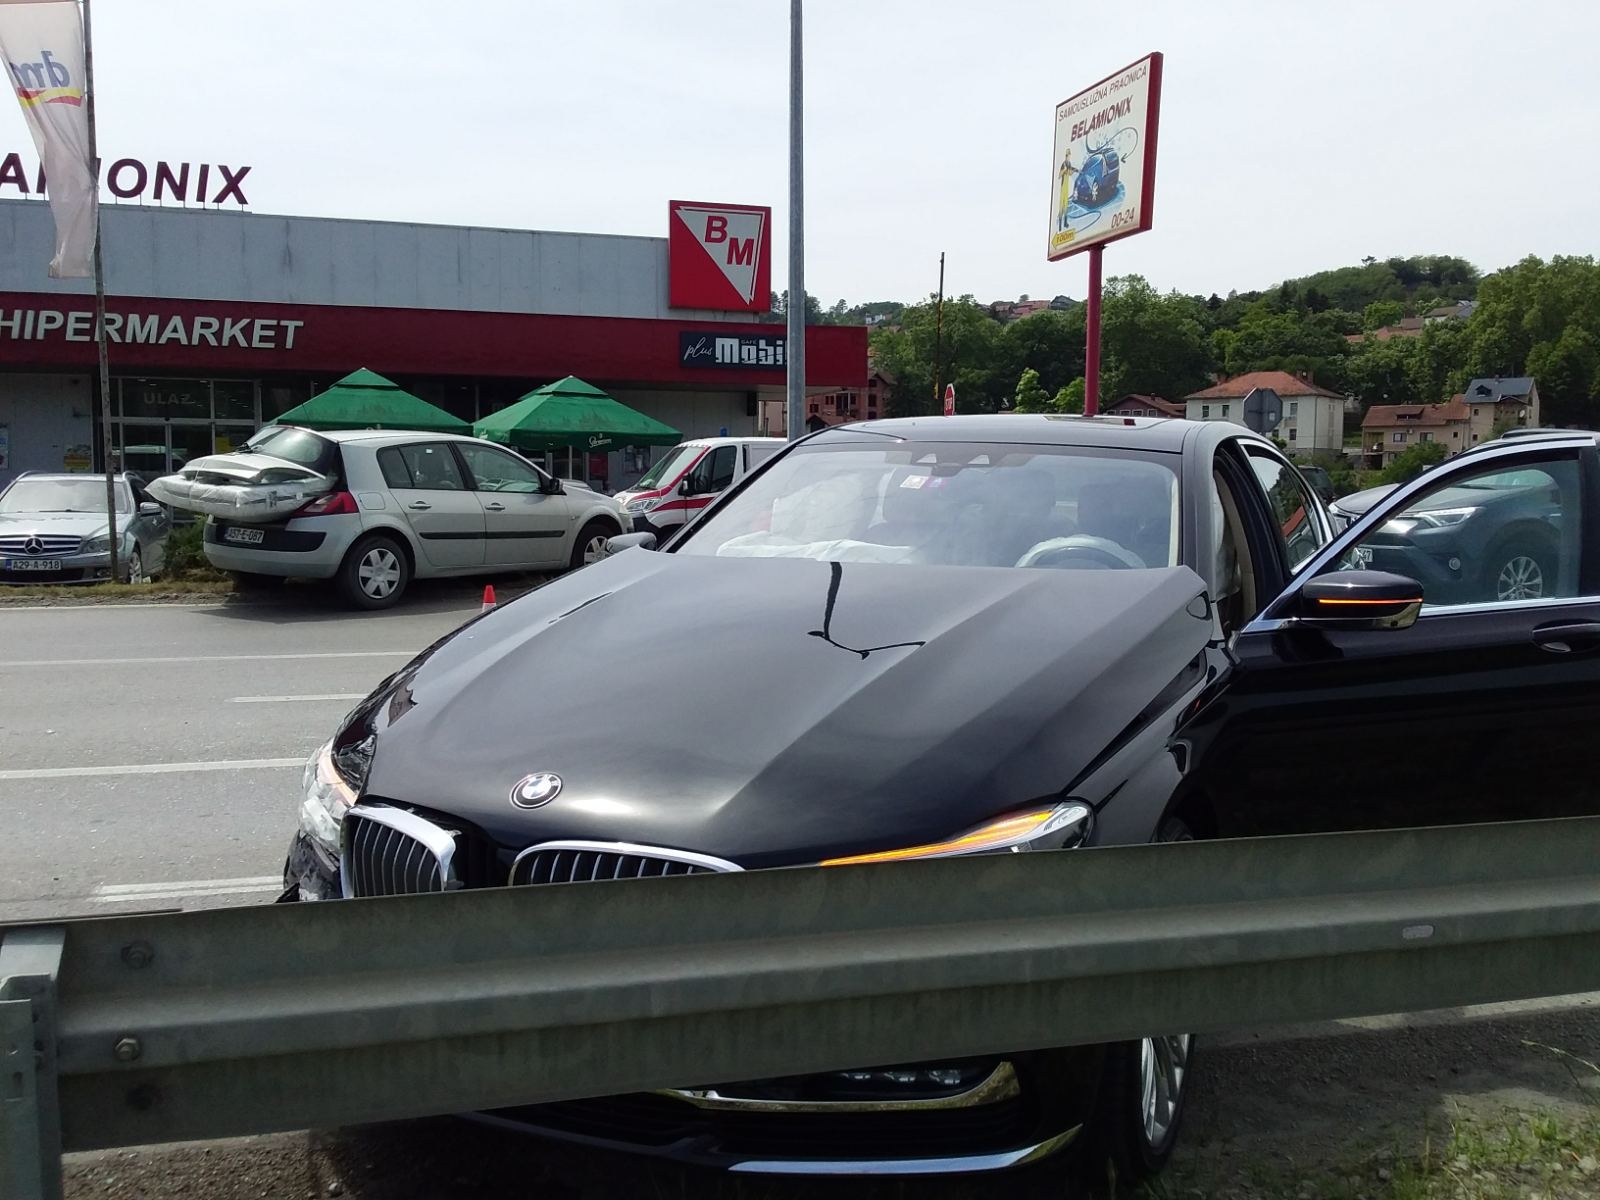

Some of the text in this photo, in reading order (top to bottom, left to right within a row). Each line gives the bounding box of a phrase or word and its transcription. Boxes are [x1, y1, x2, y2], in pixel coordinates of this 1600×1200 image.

[1109, 65, 1147, 95] PRAONICA
[1071, 95, 1134, 142] BELAMIONIX
[1111, 207, 1135, 229] 00-24
[0, 309, 304, 349] HIPERMARKET
[684, 337, 713, 361] plus
[143, 391, 193, 405] ULAZ
[13, 560, 60, 569] A29-A-918
